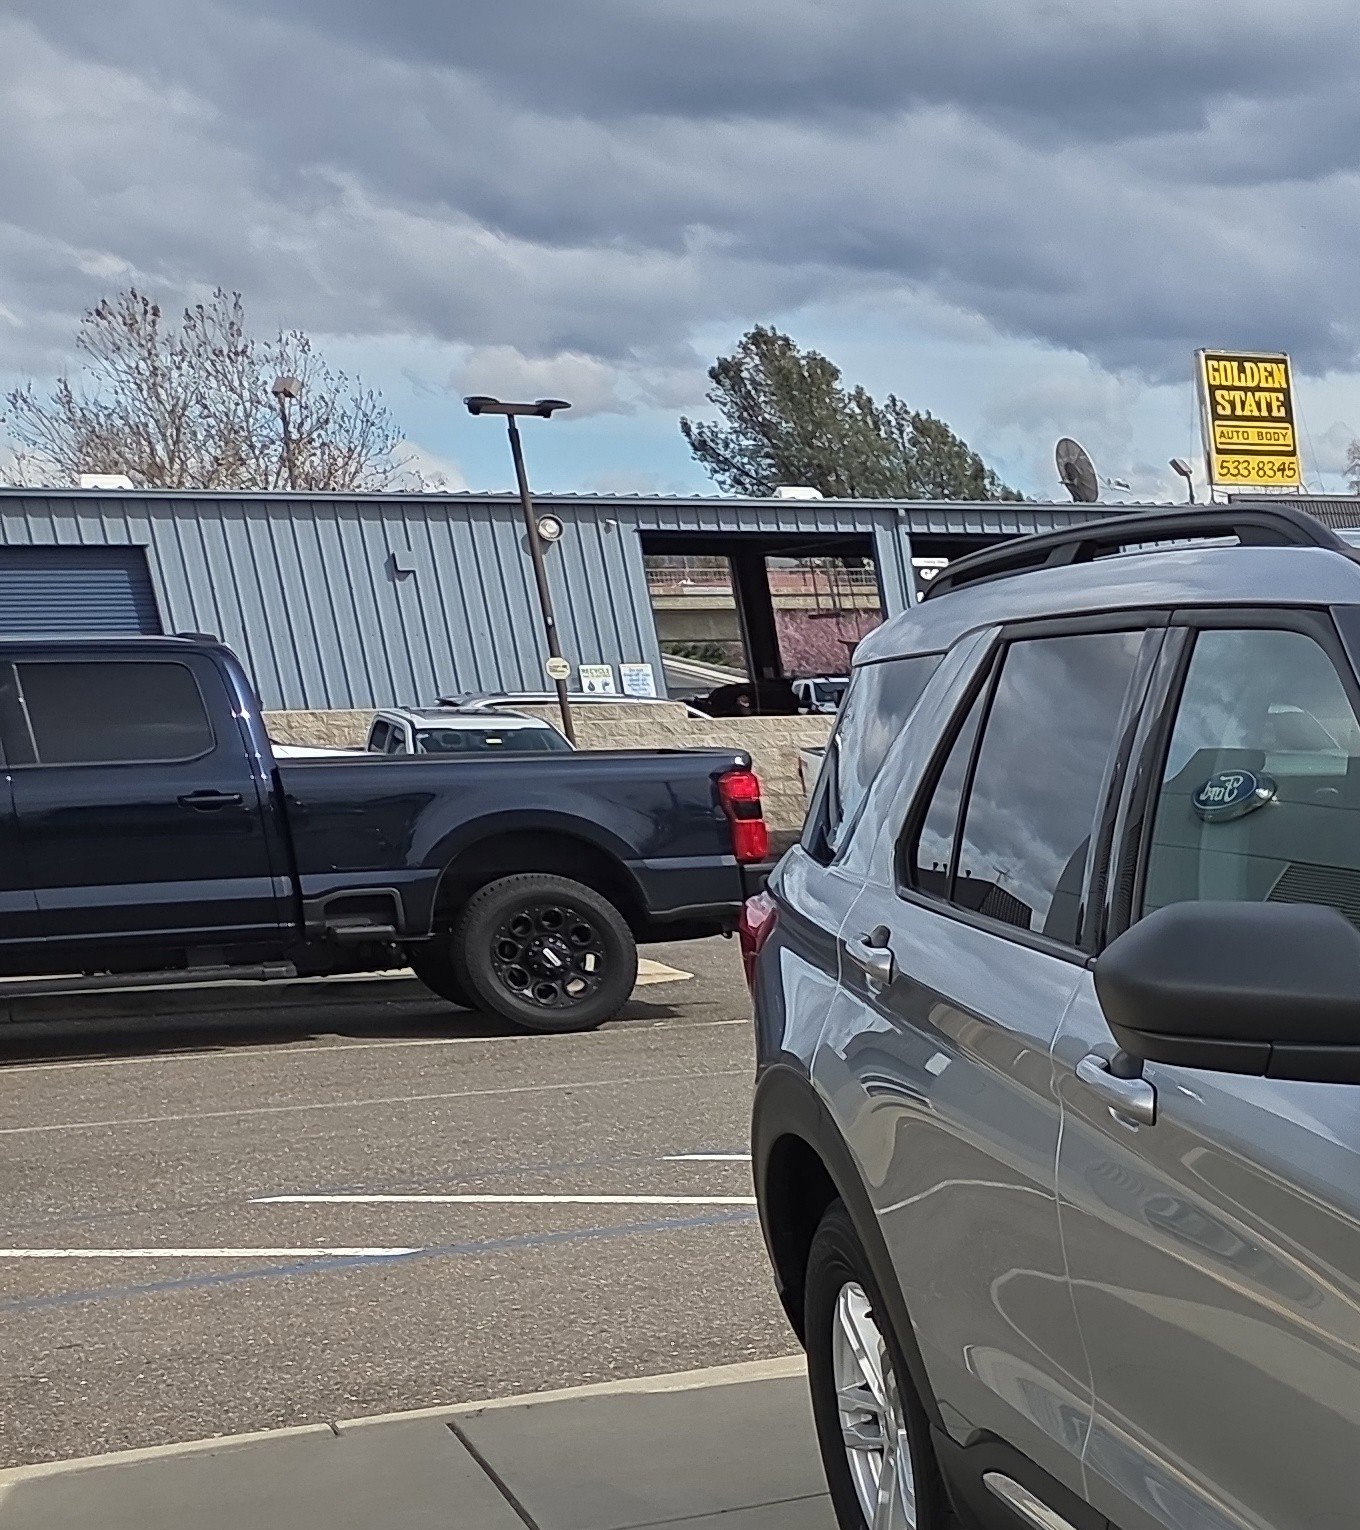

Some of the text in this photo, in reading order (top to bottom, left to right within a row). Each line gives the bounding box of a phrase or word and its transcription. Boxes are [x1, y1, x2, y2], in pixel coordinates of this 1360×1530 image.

[1207, 360, 1287, 388] GOLDEN
[1215, 390, 1286, 417] STATE
[1218, 430, 1288, 442] AUTO BODY
